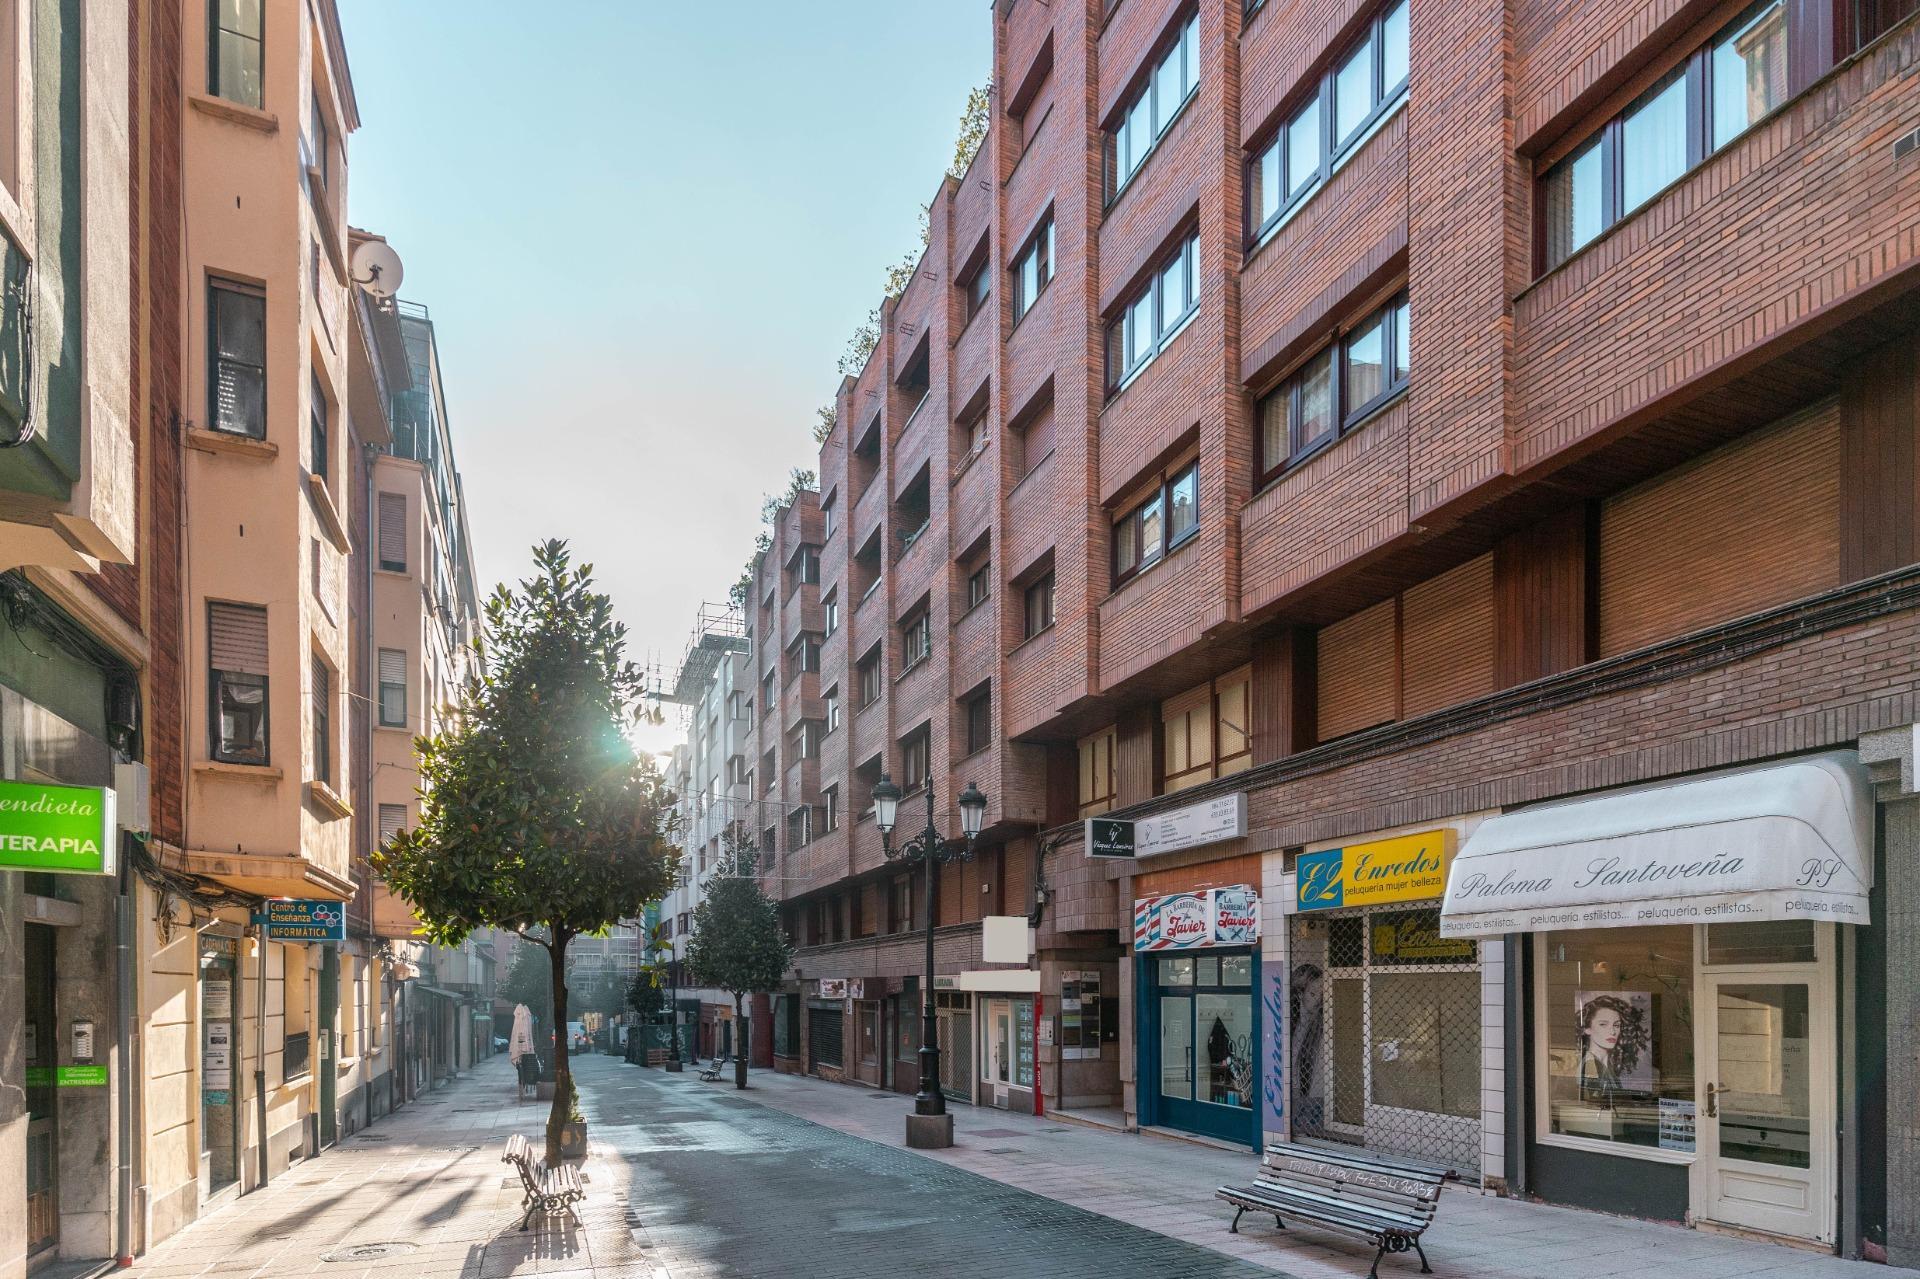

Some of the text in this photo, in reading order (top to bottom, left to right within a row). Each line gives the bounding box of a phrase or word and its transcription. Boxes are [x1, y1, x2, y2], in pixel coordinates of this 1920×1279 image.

[1354, 848, 1441, 881] Enredos
[1455, 852, 1744, 899] Paloma Santoveña
[1386, 882, 1407, 893] mujer
[1411, 876, 1441, 888] belleza
[270, 902, 307, 912] Centro de
[1704, 902, 1763, 916] estilistas...
[271, 913, 311, 923] Enseñanza
[1218, 911, 1253, 928] Javier
[271, 926, 327, 937] INFORMÁTICA
[1167, 916, 1206, 938] Javier
[1264, 975, 1283, 1117] Enredos
[60, 1079, 105, 1087] ENTRESUELO
